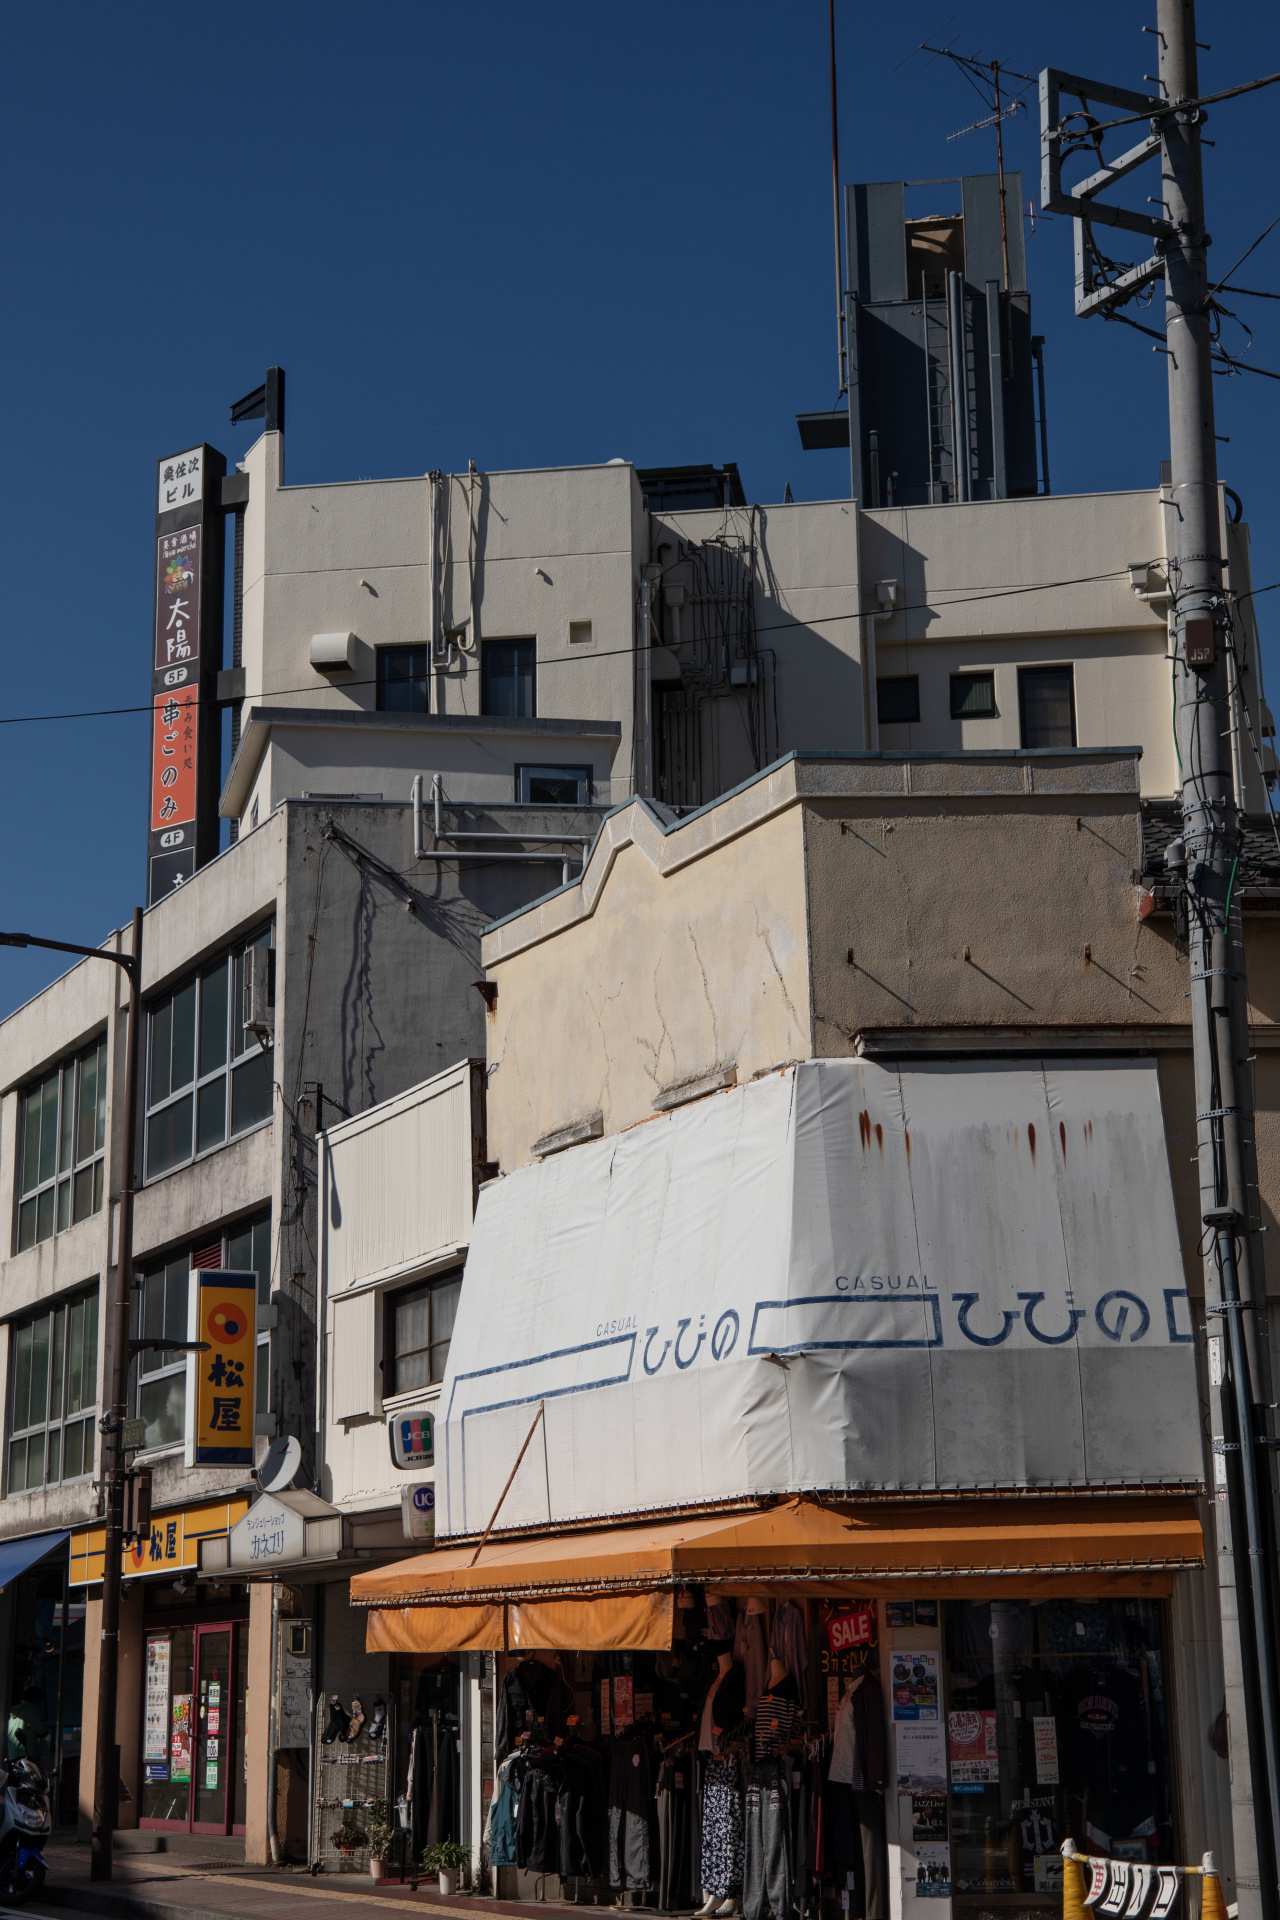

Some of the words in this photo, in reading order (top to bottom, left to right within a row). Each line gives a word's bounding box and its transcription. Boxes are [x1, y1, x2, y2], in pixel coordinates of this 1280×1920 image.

[167, 483, 194, 503] ビル
[168, 670, 184, 684] 5F
[160, 697, 181, 820] 串ごのみ
[164, 831, 181, 845] 4F
[835, 1275, 938, 1291] CASUAL
[596, 1315, 639, 1338] CASUAL
[207, 1353, 245, 1432] 松屋
[403, 1431, 431, 1441] JCB
[247, 1512, 285, 1531] ランジェリーショップ
[149, 1521, 177, 1562] 松屋
[831, 1614, 870, 1648] SALE
[958, 1785, 983, 1793] Columbia
[1011, 1796, 1056, 1810] RESSTANT
[969, 1878, 1016, 1886] Columbia
